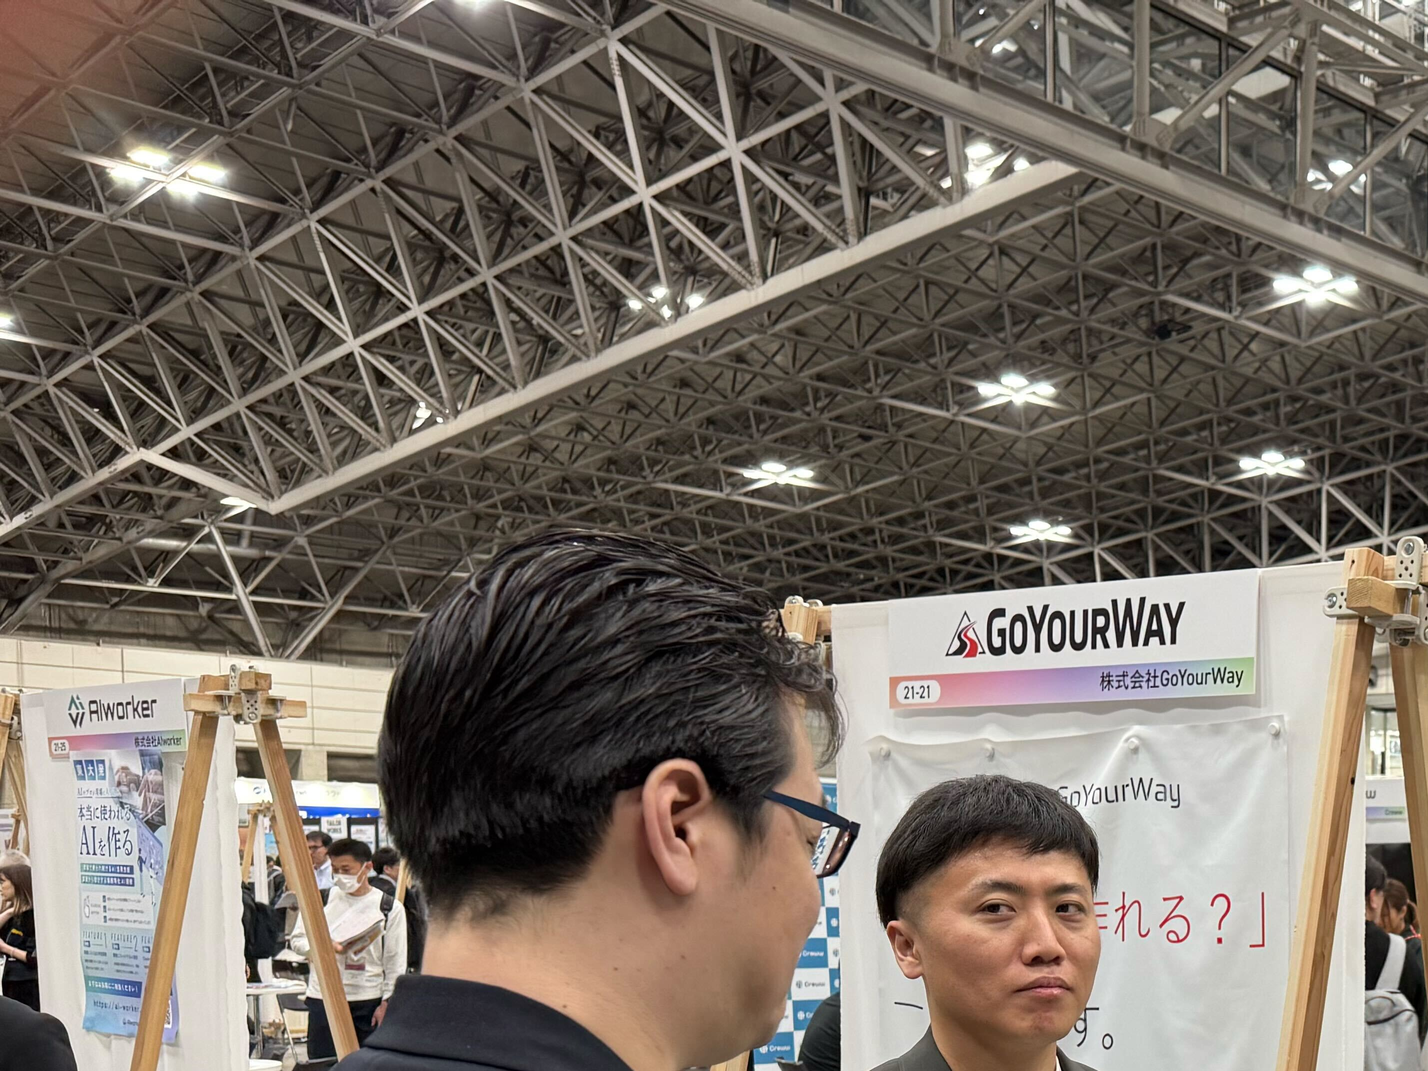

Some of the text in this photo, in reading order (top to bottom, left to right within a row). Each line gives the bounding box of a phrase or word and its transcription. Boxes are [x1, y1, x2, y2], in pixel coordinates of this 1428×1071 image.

[1100, 667, 1243, 691] 株式会社GoYourWay
[904, 686, 931, 700] 21-21
[89, 696, 157, 722] AIworker
[78, 805, 131, 822] 本当に使われる
[80, 825, 133, 857] AIを作る
